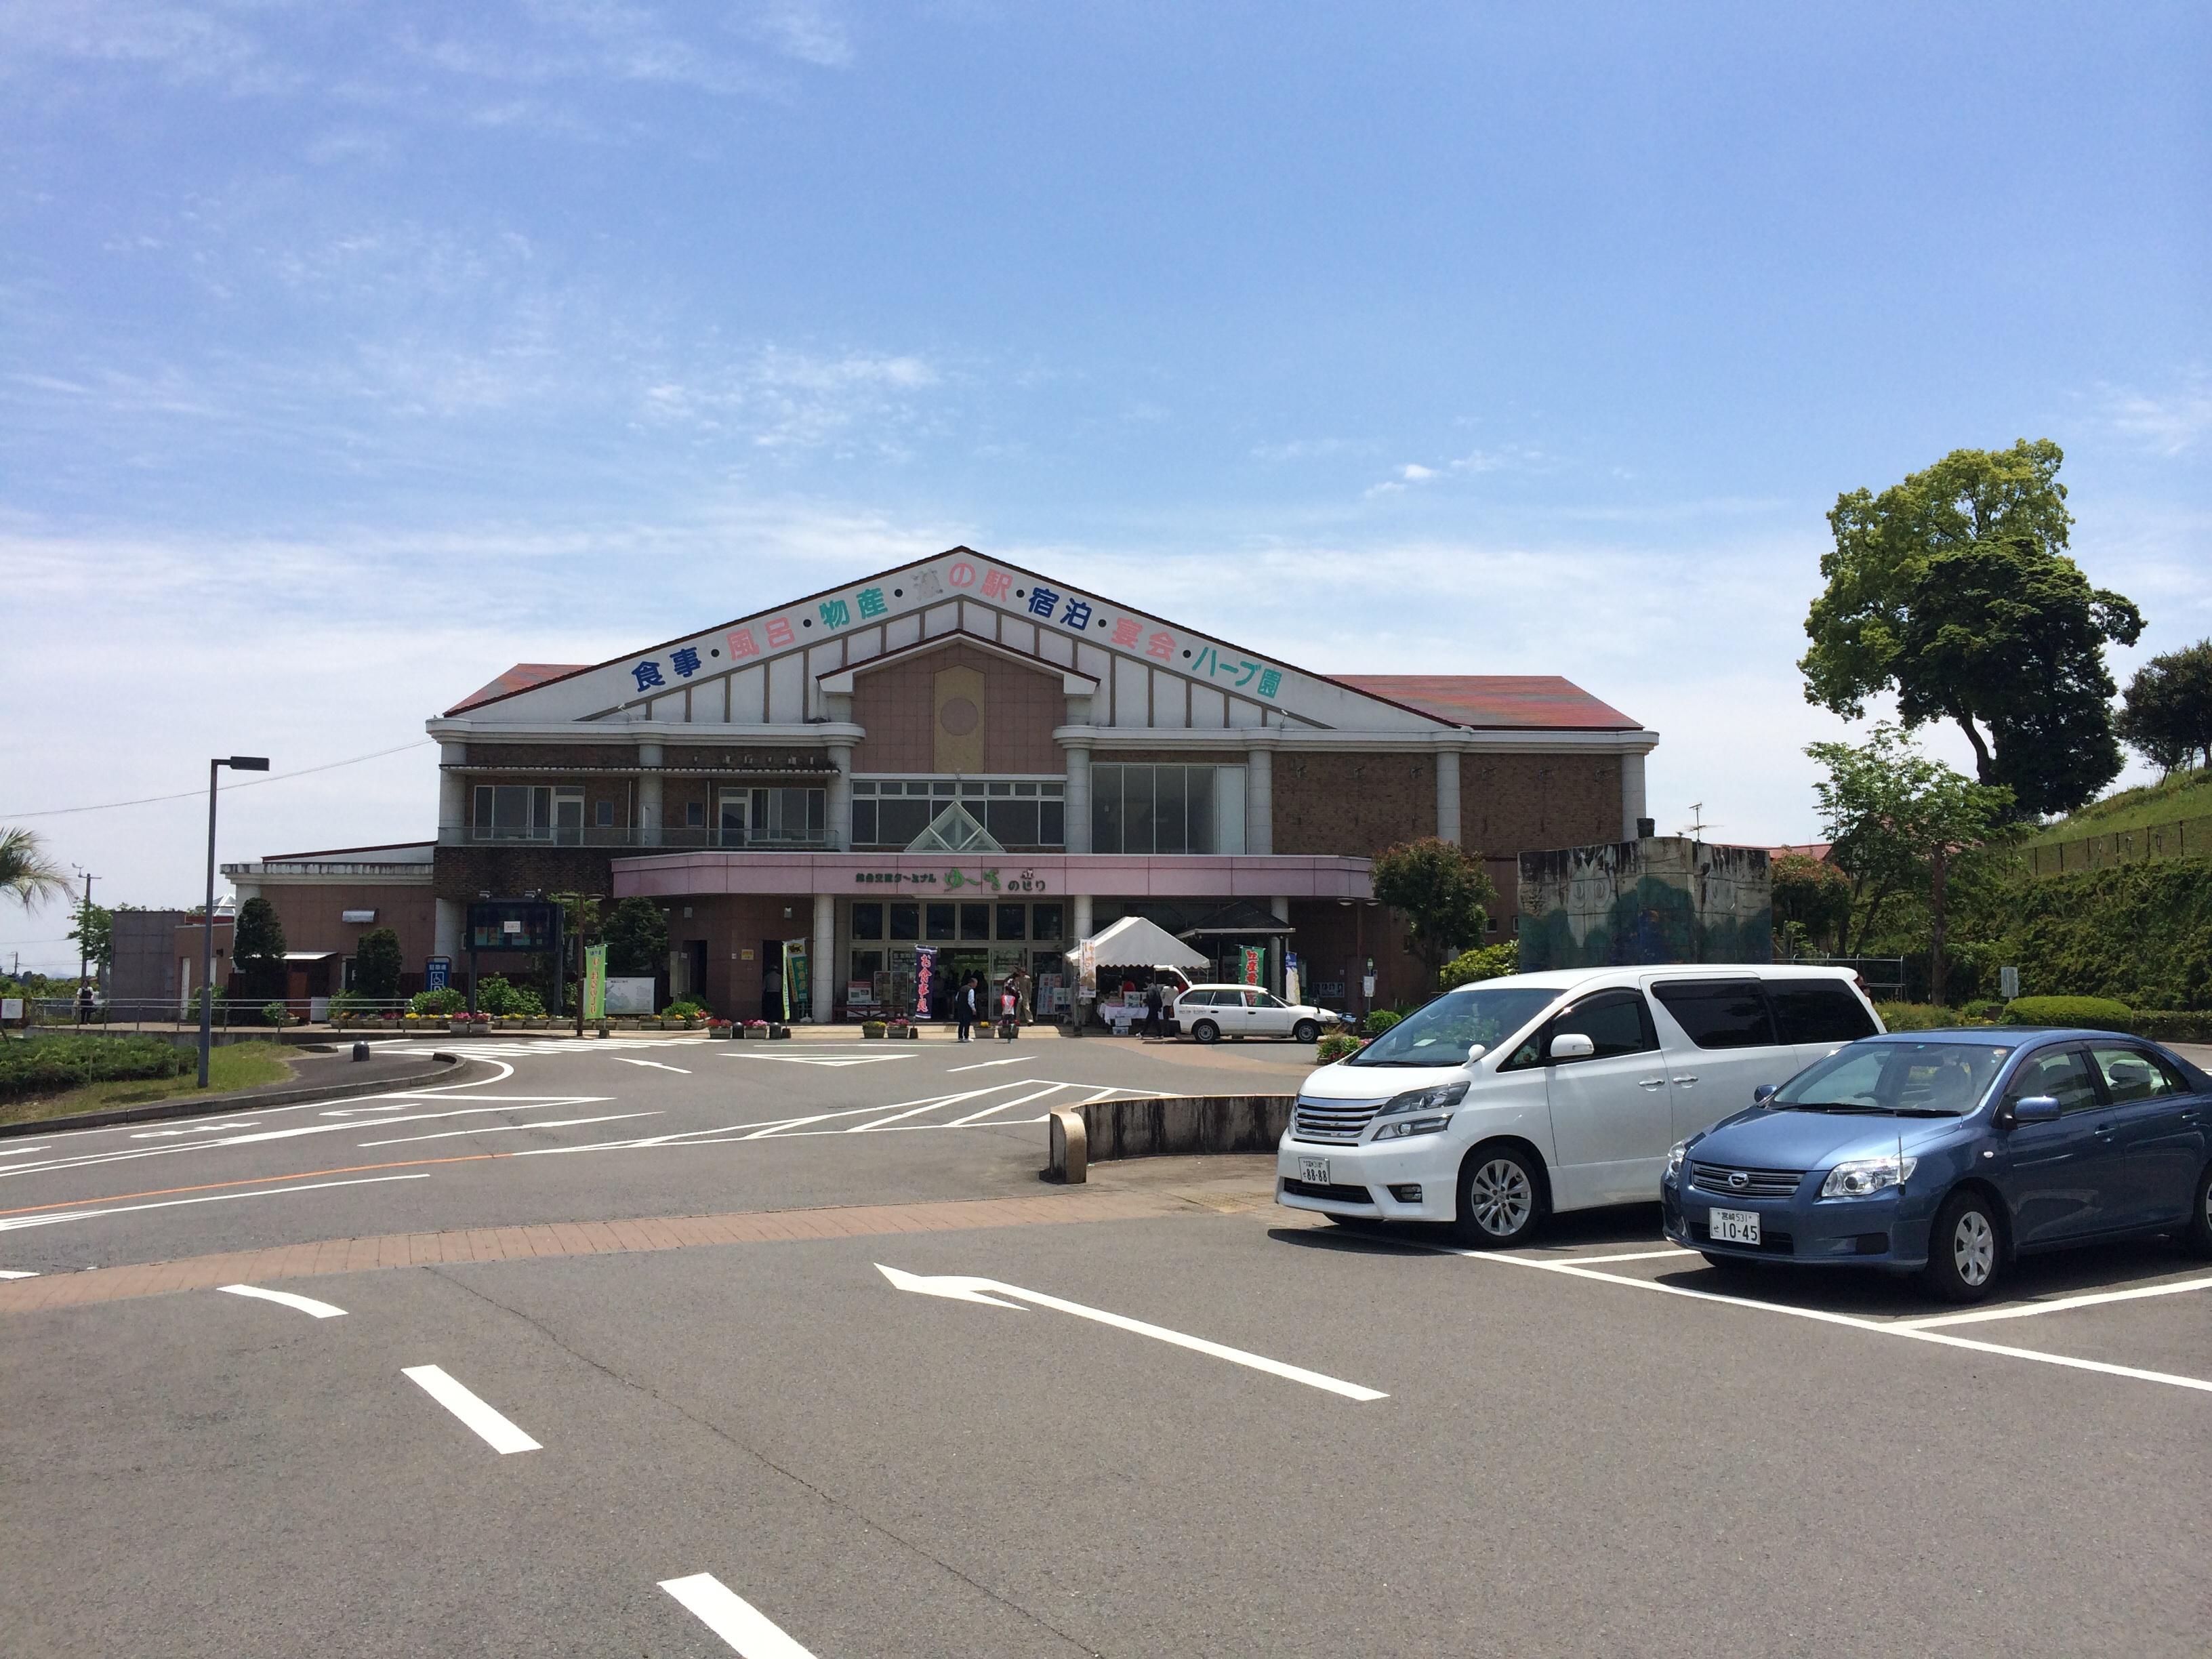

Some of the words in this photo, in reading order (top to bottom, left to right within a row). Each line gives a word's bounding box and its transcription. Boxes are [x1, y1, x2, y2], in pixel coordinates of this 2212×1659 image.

[632, 647, 701, 693] 食事
[727, 617, 796, 661] 風呂
[819, 588, 888, 630] 物産
[1028, 587, 1092, 631] 宿泊
[1110, 617, 1176, 661] 宴会
[916, 954, 933, 1012] お食事処
[1723, 1221, 1758, 1241] 10-45
